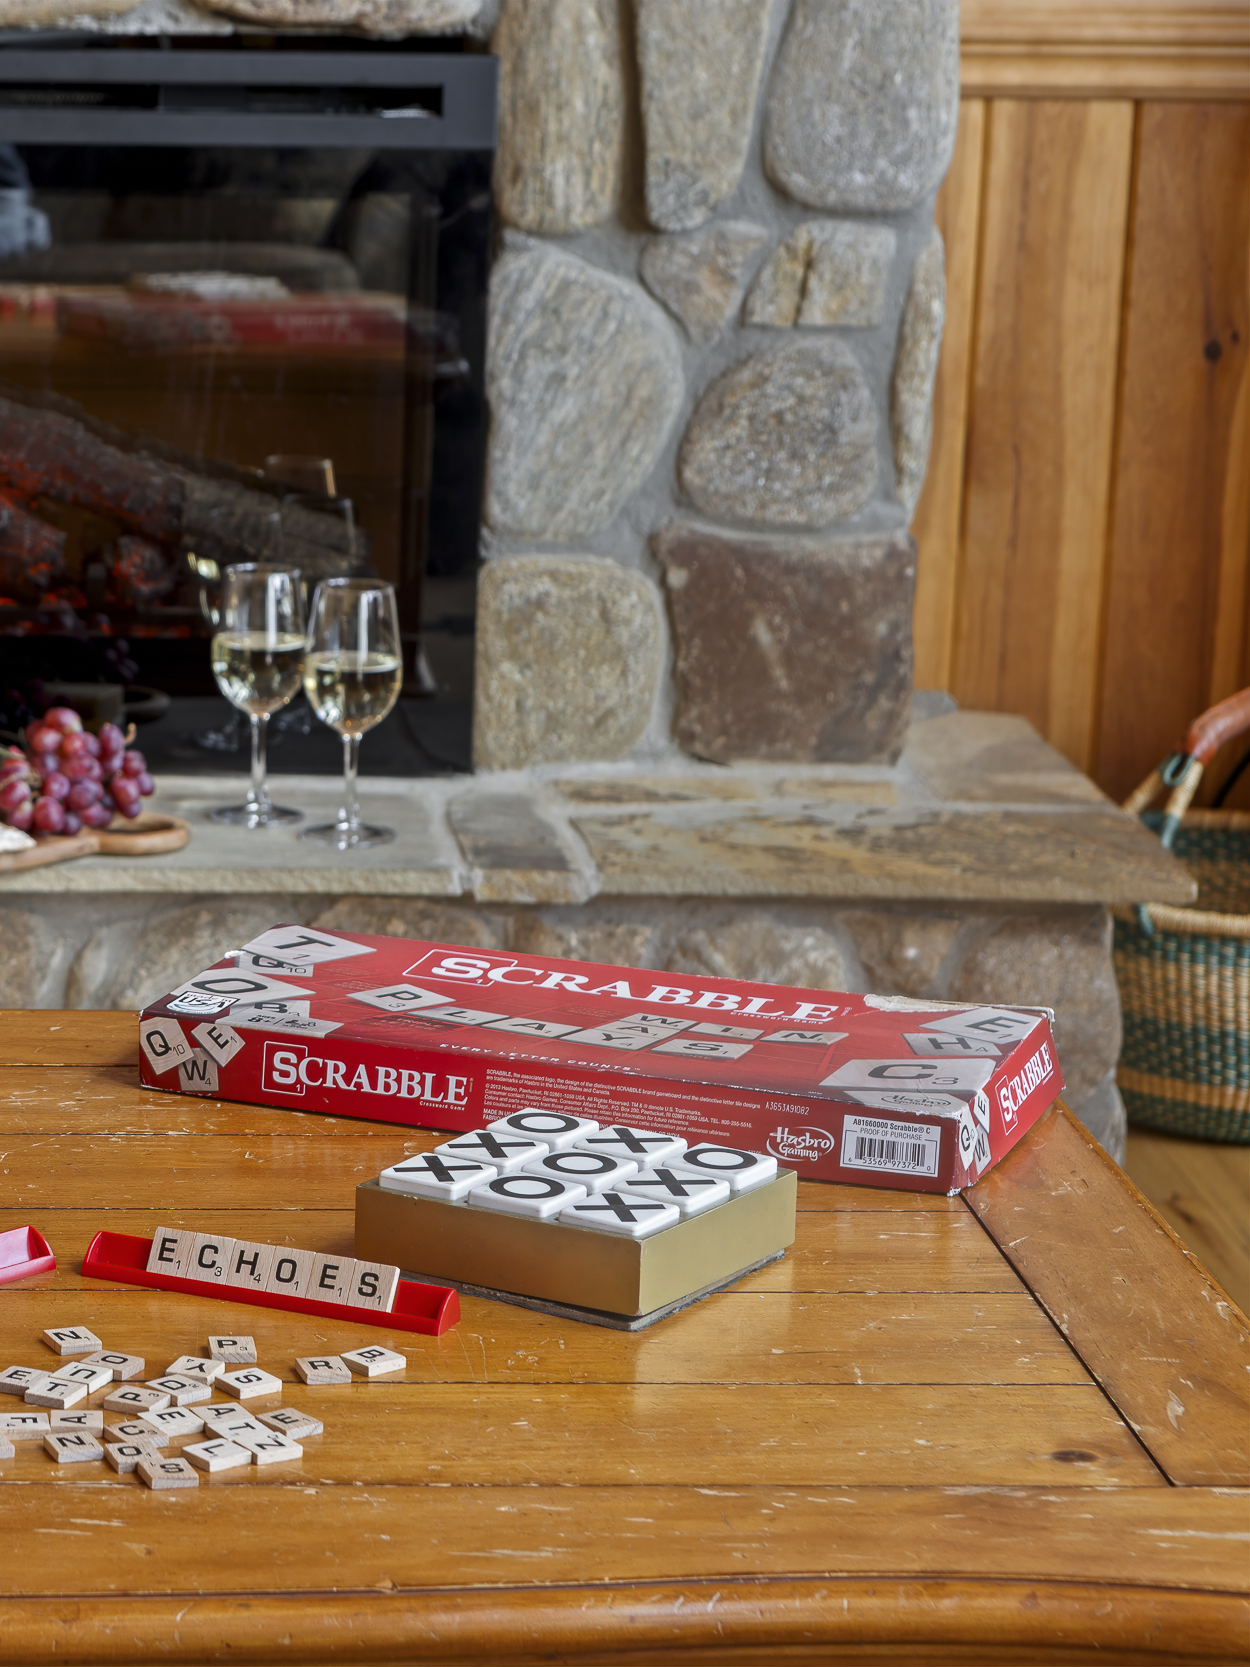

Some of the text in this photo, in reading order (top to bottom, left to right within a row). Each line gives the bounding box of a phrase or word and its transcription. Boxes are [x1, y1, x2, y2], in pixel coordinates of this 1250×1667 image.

[431, 957, 839, 1022] SCRABBLE
[178, 997, 226, 1008] USA
[730, 1011, 789, 1022] Crossword
[440, 1043, 492, 1053] EVERY
[499, 1050, 560, 1062] LETTER
[272, 1051, 468, 1105] SCRABBLE
[999, 1041, 1053, 1122] SCRABBLE
[419, 1100, 448, 1110] Crossword
[765, 1101, 810, 1116] A3653A91082
[853, 1118, 888, 1130] A81660000
[770, 1127, 830, 1149] Hasbro
[860, 1128, 880, 1136] PROOF
[890, 1130, 923, 1141] PURCHASE
[779, 1142, 818, 1162] Gaming
[862, 1157, 888, 1167] 53569
[891, 1160, 918, 1170] 97372
[157, 1237, 380, 1298] ECHOES
[216, 1339, 238, 1348] P
[307, 1360, 334, 1370] R
[6, 1370, 31, 1380] E
